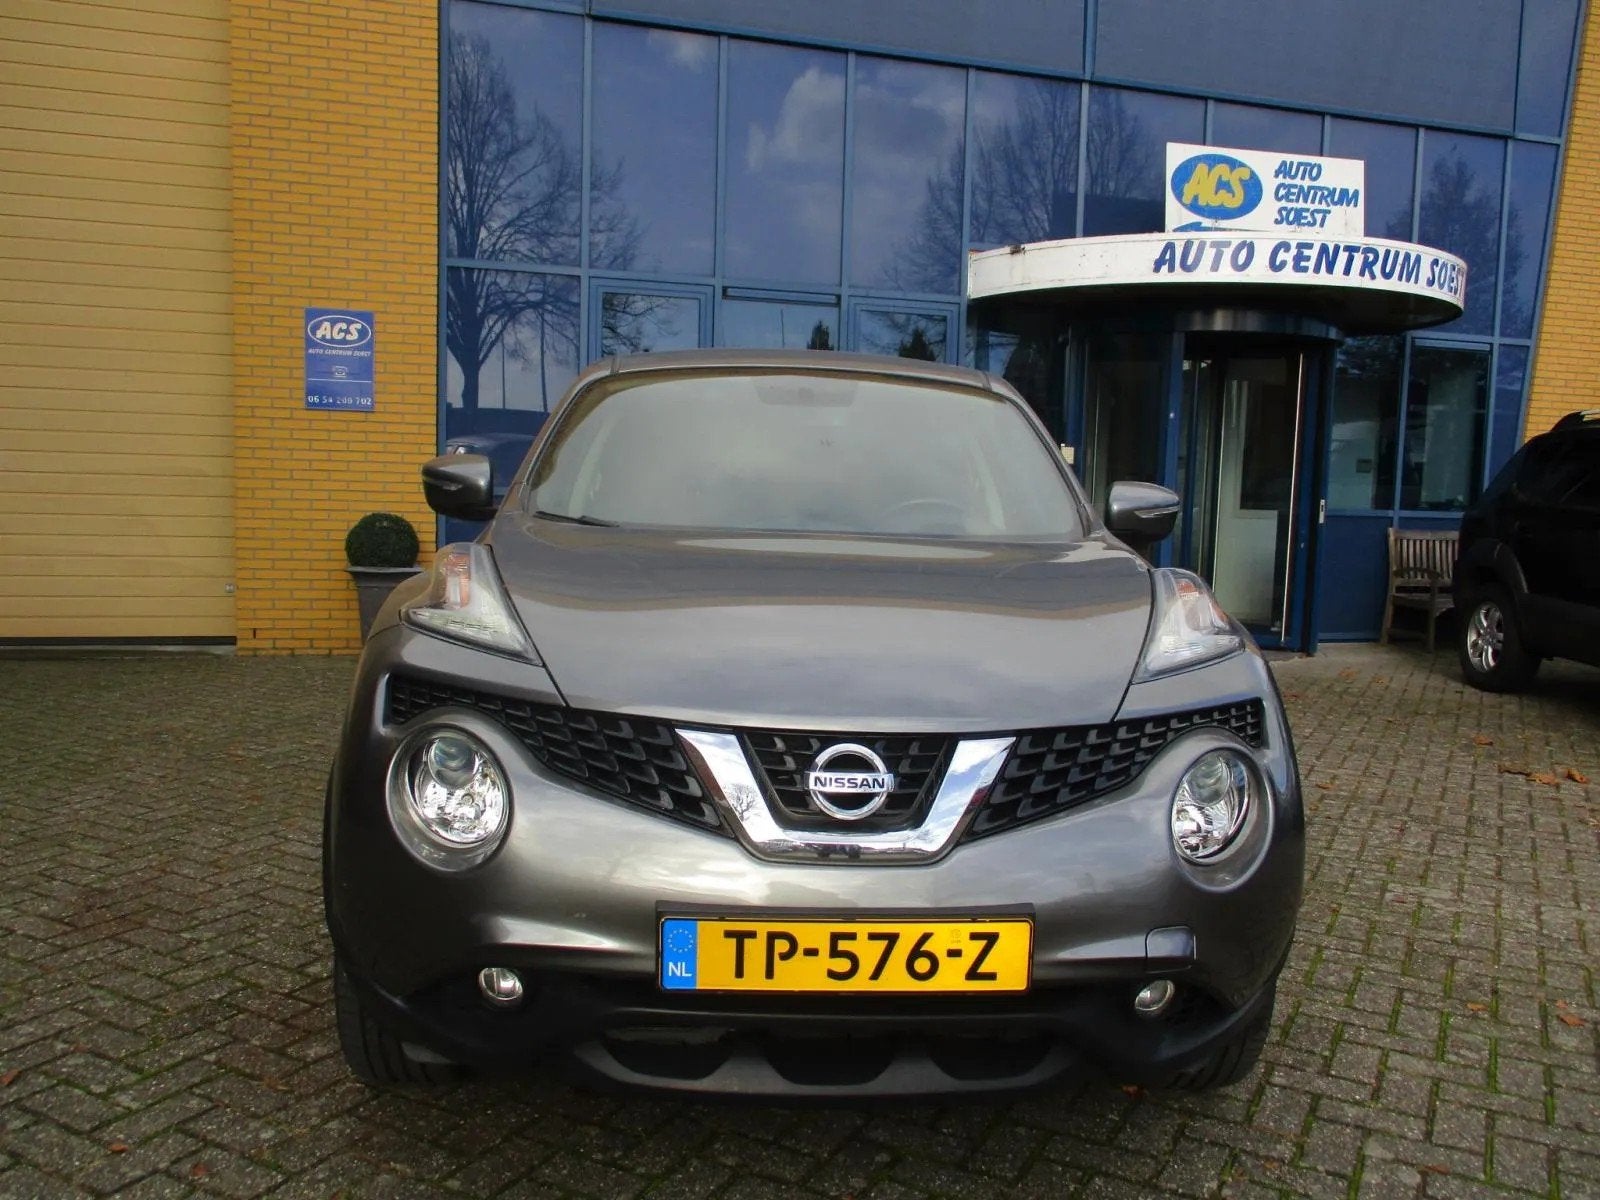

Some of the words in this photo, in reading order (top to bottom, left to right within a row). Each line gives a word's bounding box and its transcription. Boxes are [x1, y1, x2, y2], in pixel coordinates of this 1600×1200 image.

[1274, 160, 1323, 182] AUTO
[1182, 162, 1251, 209] ACS
[1274, 183, 1360, 208] CENTRUM
[1274, 206, 1331, 228] SOEST
[1153, 240, 1255, 274] AUTO
[1268, 240, 1422, 285] CENTRUM
[316, 321, 362, 341] ACS
[814, 776, 885, 789] NISSAN
[723, 930, 1000, 982] TP-576-Z
[668, 961, 692, 977] NL
